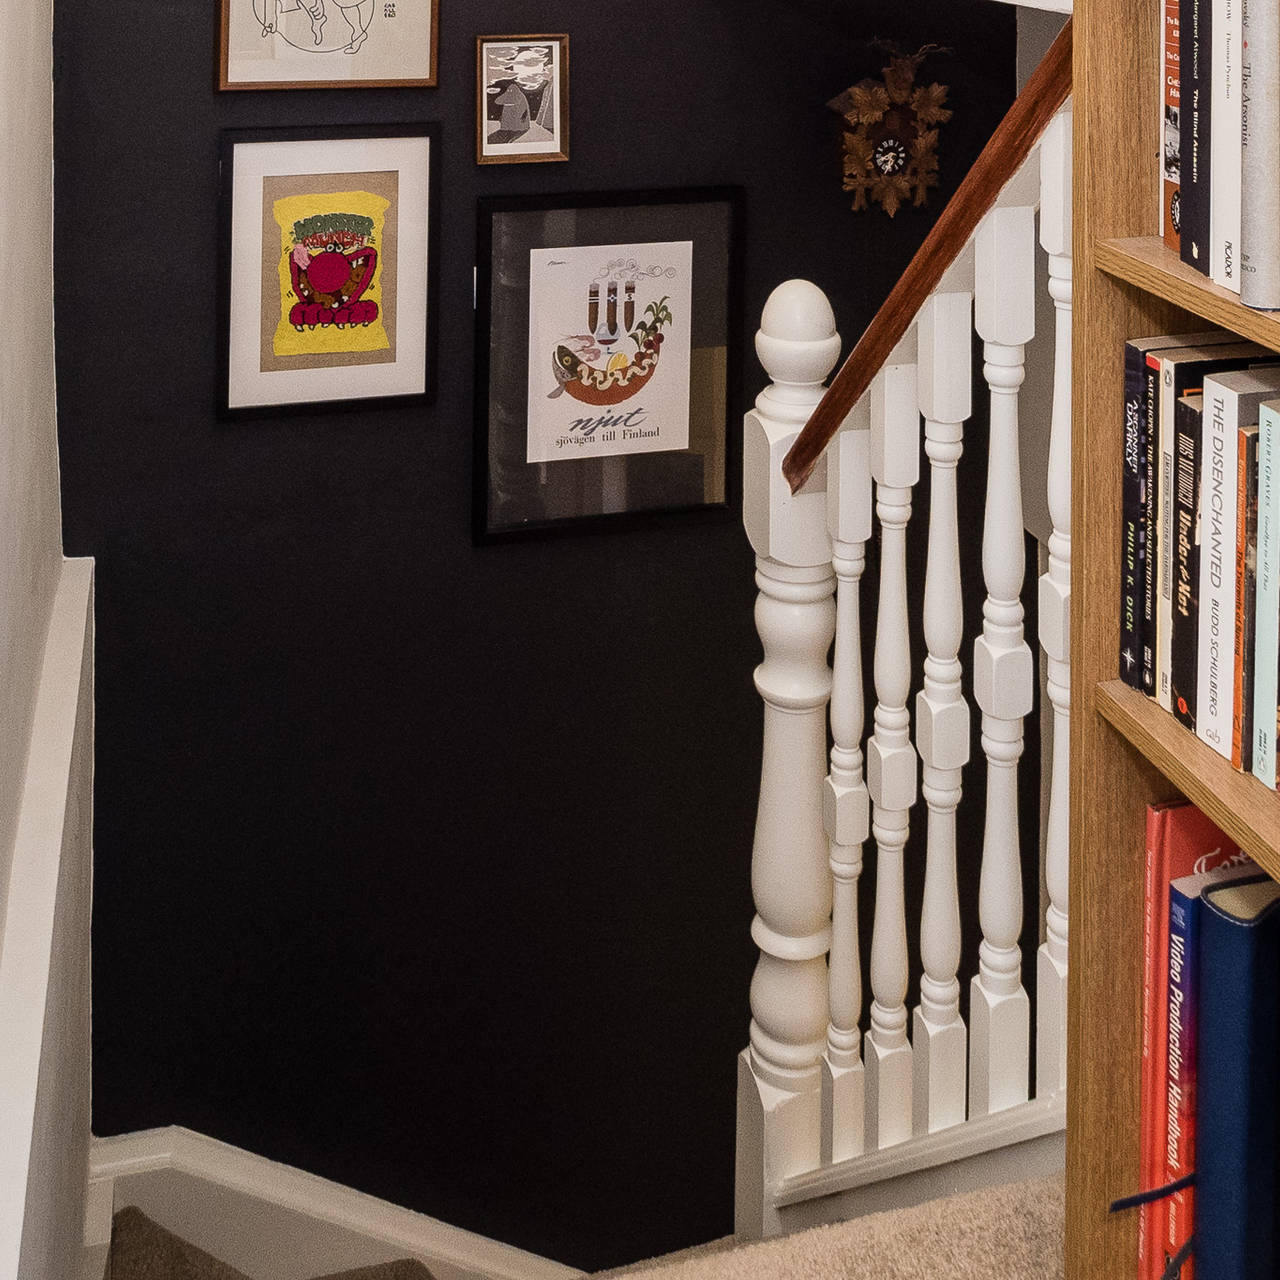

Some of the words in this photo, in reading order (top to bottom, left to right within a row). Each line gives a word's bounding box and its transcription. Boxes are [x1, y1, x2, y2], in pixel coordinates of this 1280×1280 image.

[1225, 240, 1233, 279] PICADOR
[569, 407, 652, 436] njut
[1212, 398, 1224, 432] THE
[554, 433, 597, 449] sjövägen
[602, 430, 616, 442] till
[622, 426, 660, 440] Finland
[1207, 435, 1224, 589] DISENCHANTED
[1126, 521, 1135, 570] PHILIP
[1126, 575, 1134, 589] K.
[1126, 597, 1134, 632] DICK
[1208, 598, 1219, 636] BUDD
[1207, 638, 1219, 717] SCHULBERG
[1171, 932, 1186, 986] Video
[1169, 987, 1186, 1081] Production
[1167, 1083, 1183, 1170] Handbook
